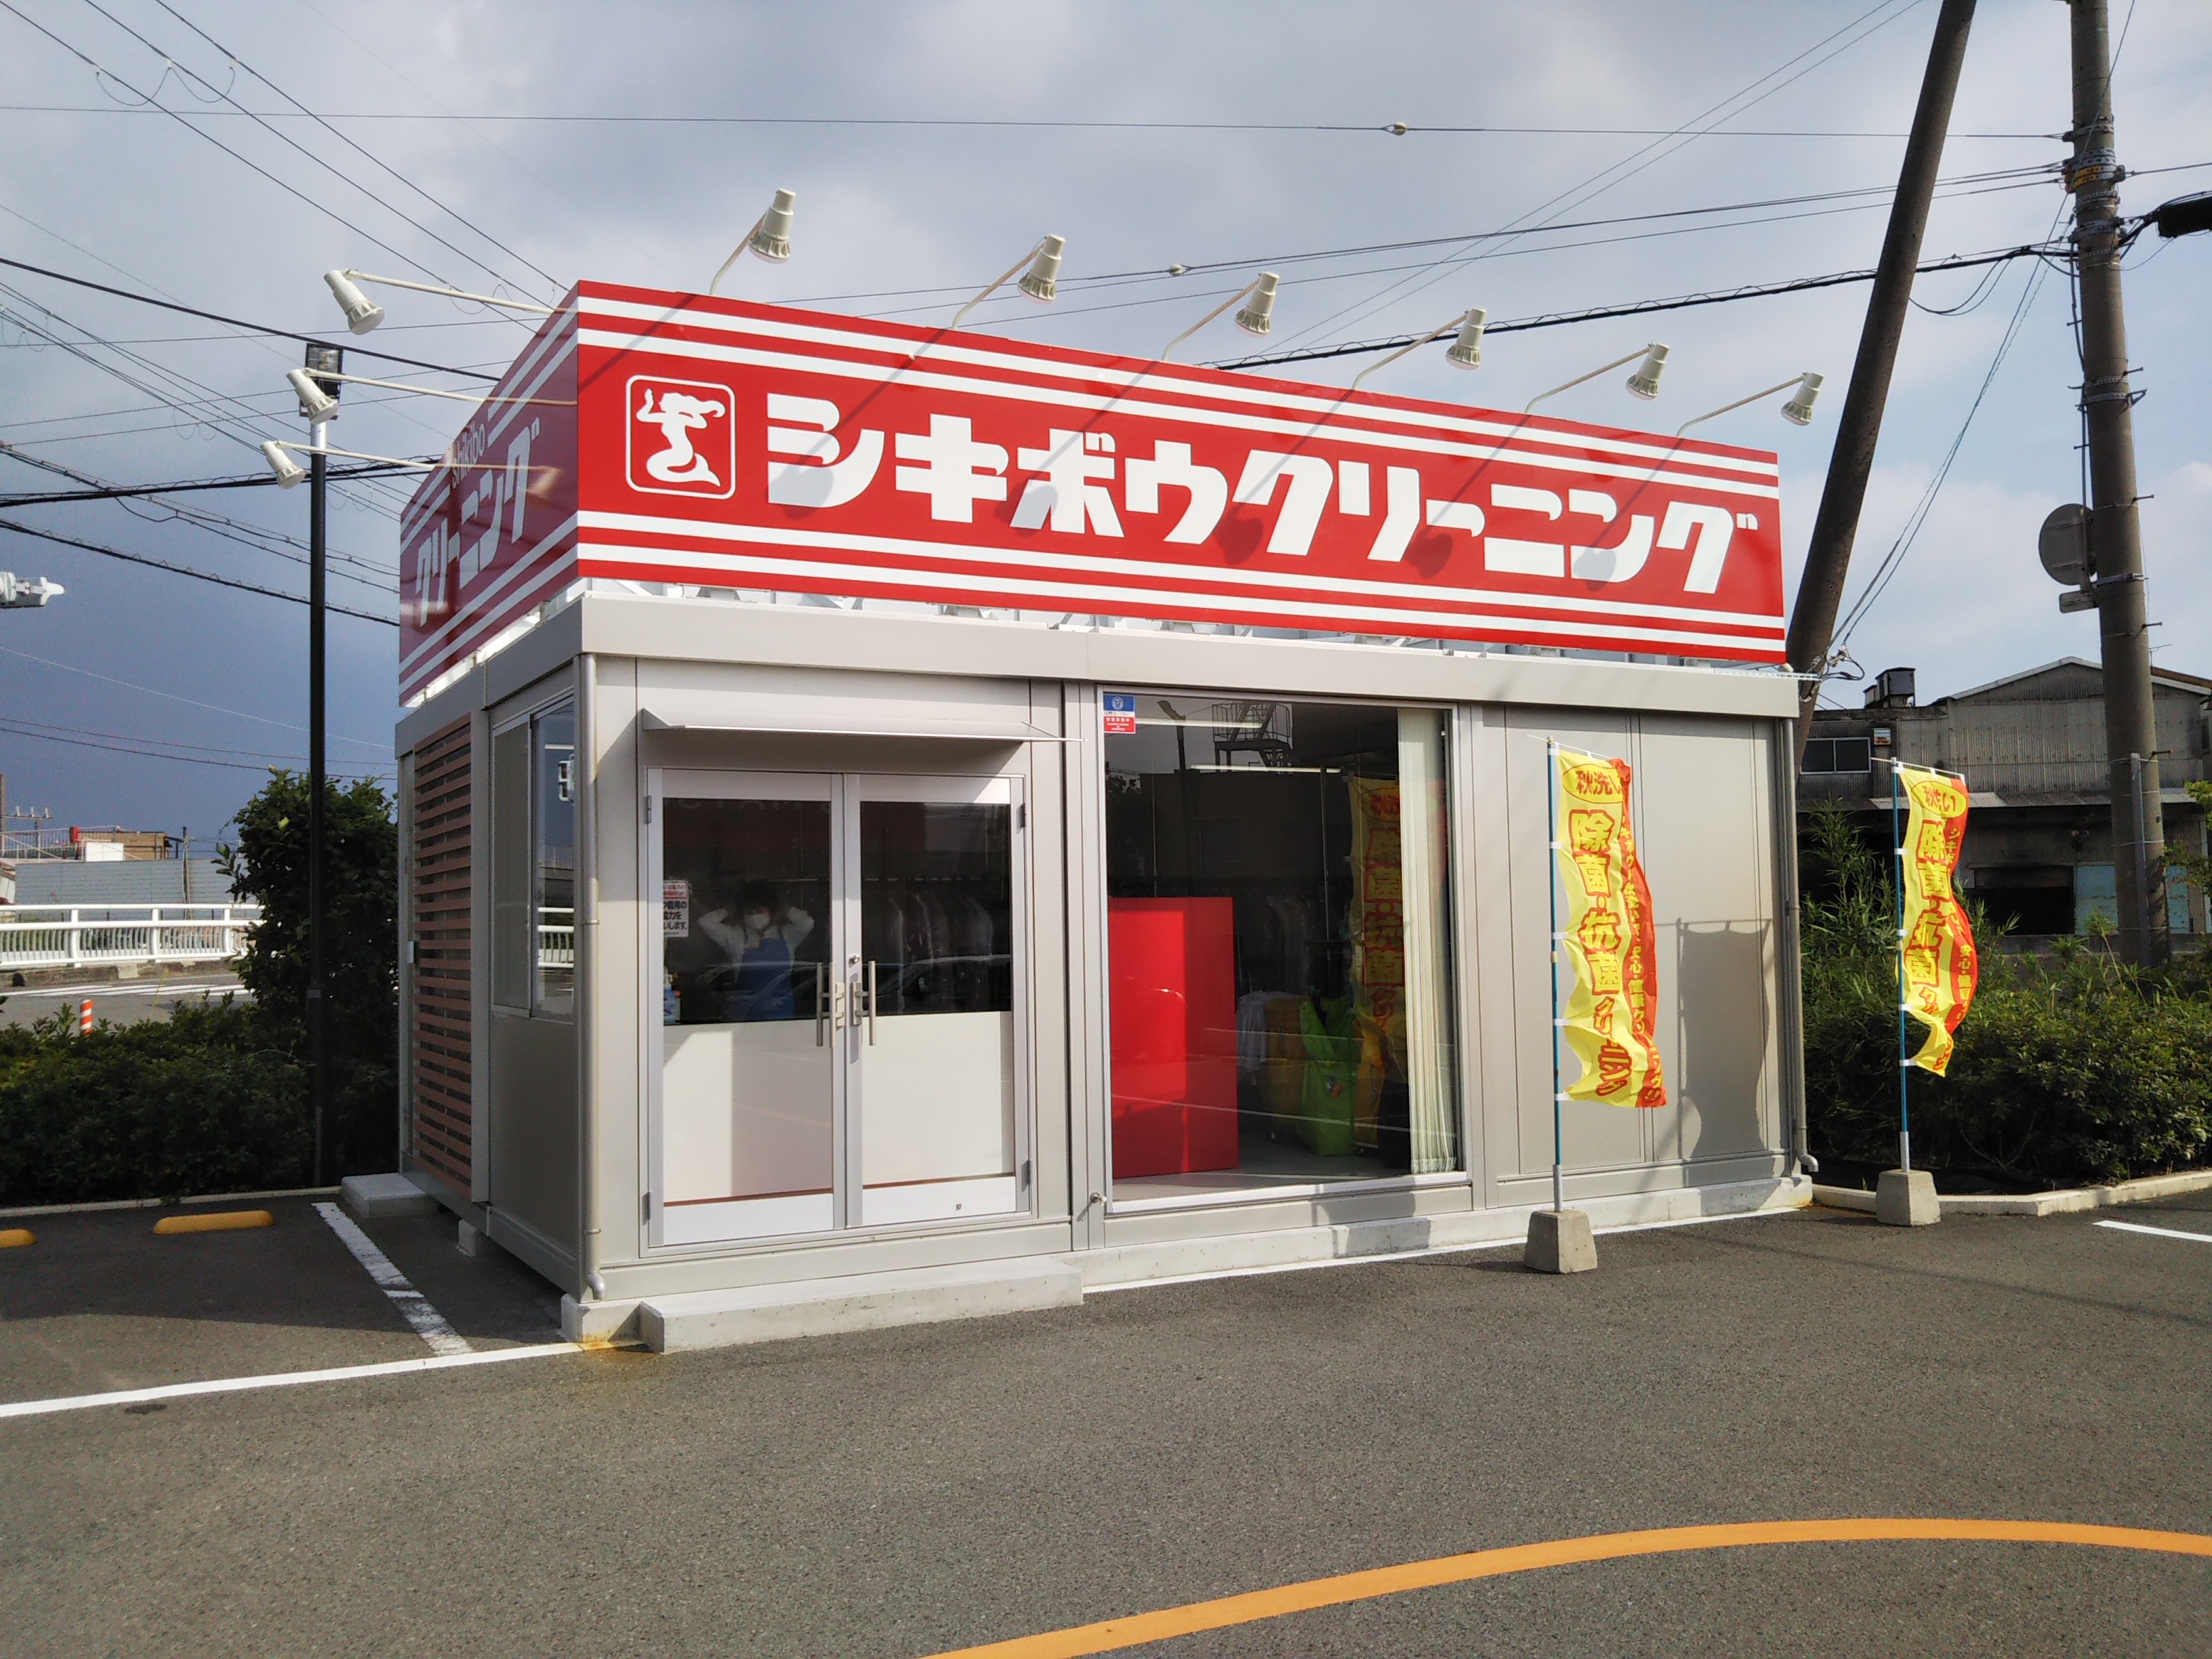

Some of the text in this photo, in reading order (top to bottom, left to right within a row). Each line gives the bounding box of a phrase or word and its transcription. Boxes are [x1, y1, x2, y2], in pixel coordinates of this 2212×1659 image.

[415, 417, 540, 627] クリーニング
[766, 392, 1759, 594] シキボウクリーニング
